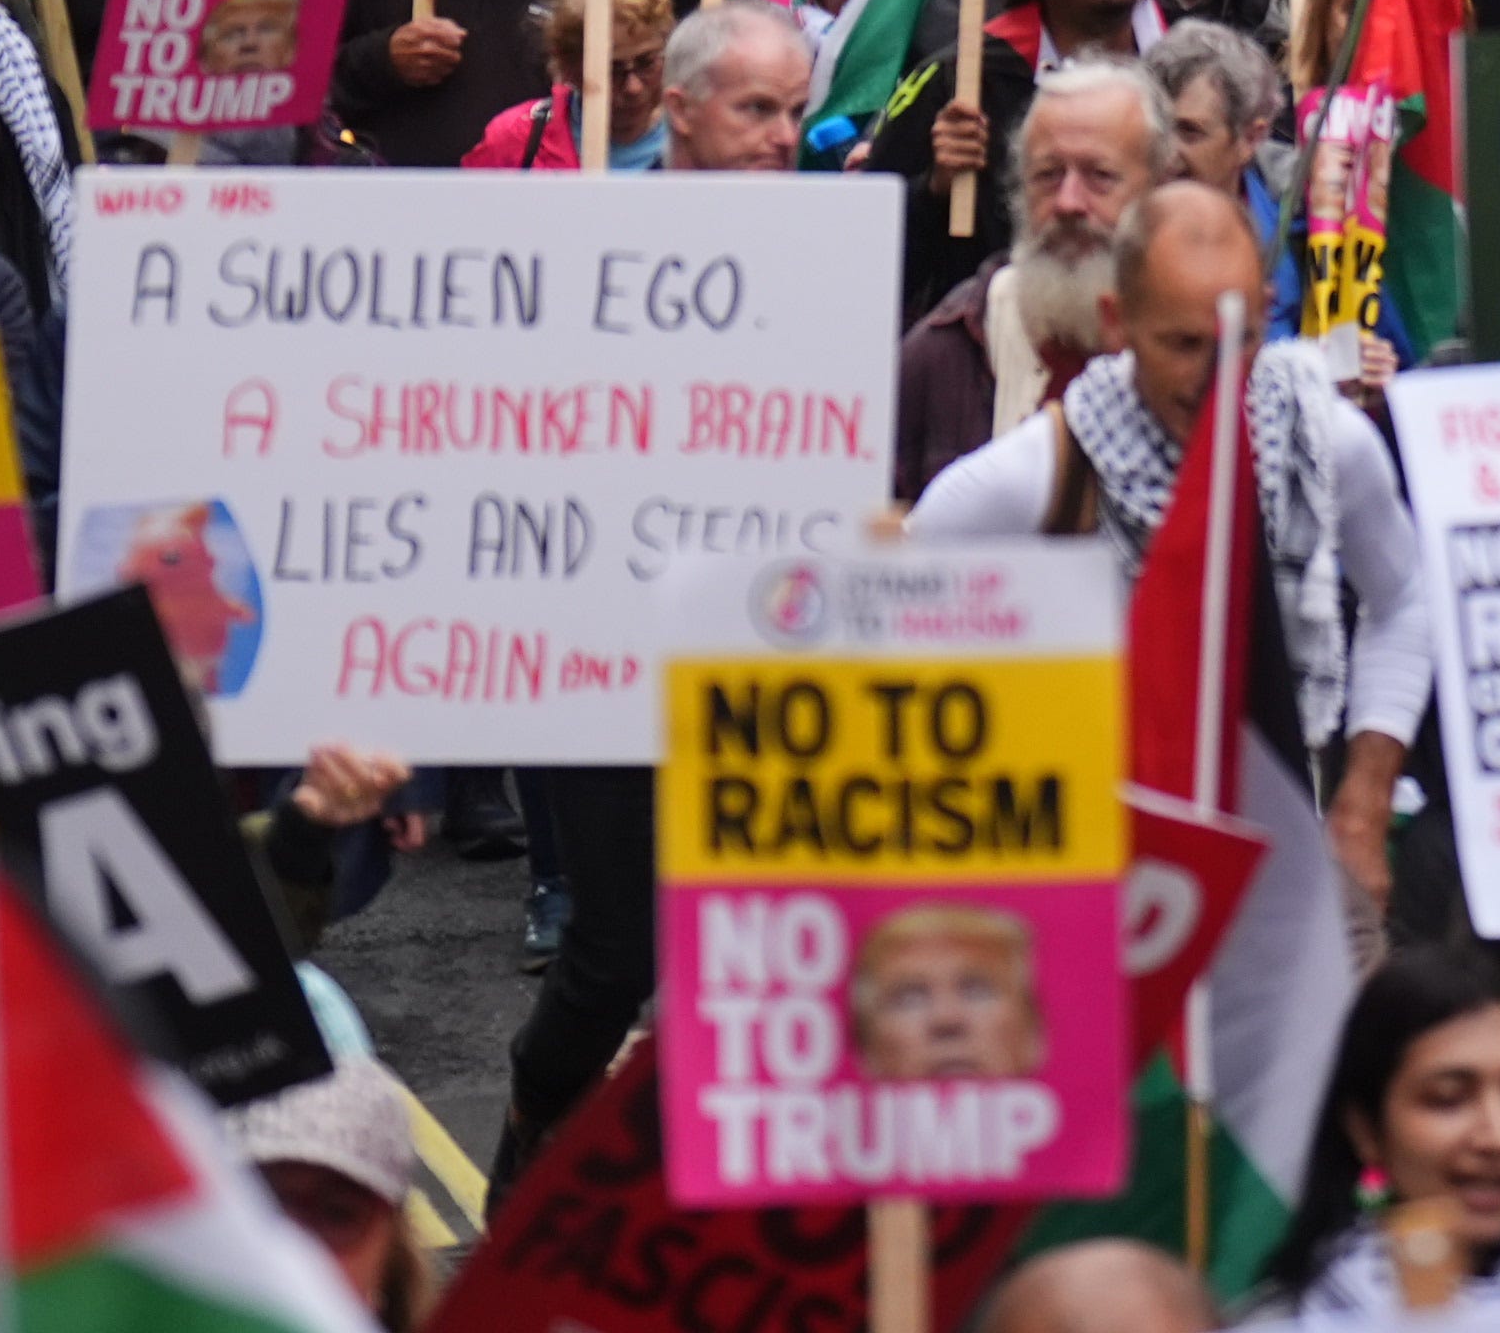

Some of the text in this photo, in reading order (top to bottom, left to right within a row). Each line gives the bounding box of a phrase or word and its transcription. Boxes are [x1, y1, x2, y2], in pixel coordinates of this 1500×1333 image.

[132, 244, 180, 325] A
[208, 240, 543, 329] SWOLLEN
[223, 382, 279, 459] A
[324, 374, 653, 461] SHRUNKEN
[272, 494, 593, 583] LIES AND
[336, 617, 544, 704] AGAIN
[703, 679, 988, 761] NO TO
[708, 773, 1067, 858] RACISM
